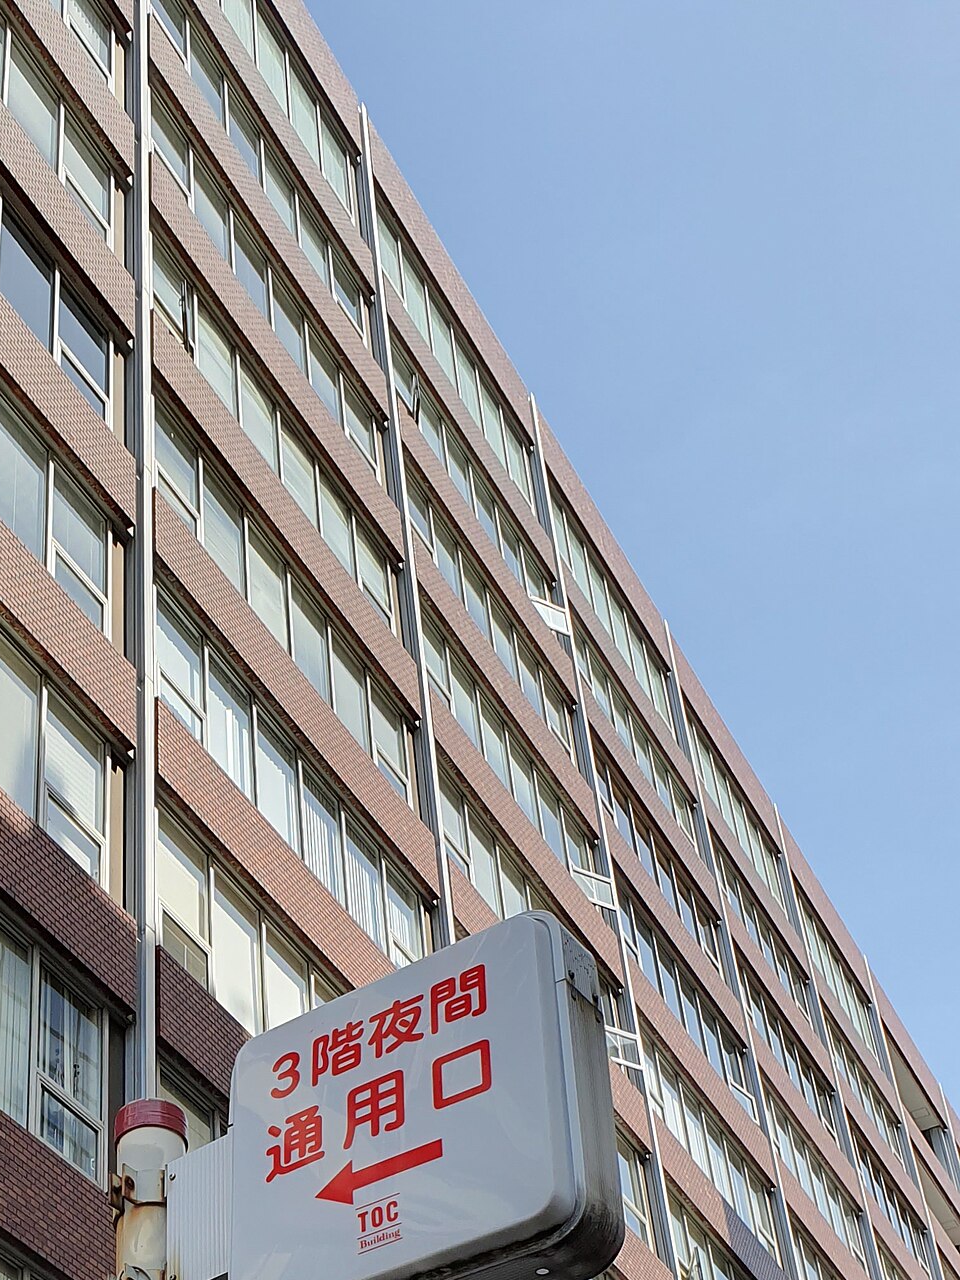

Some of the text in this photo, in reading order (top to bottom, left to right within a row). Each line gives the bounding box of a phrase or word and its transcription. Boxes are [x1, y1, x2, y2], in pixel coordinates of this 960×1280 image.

[270, 963, 488, 1099] 3階夜間
[265, 1038, 492, 1183] 通用口
[357, 1200, 399, 1233] TOC
[360, 1228, 401, 1249] Building
